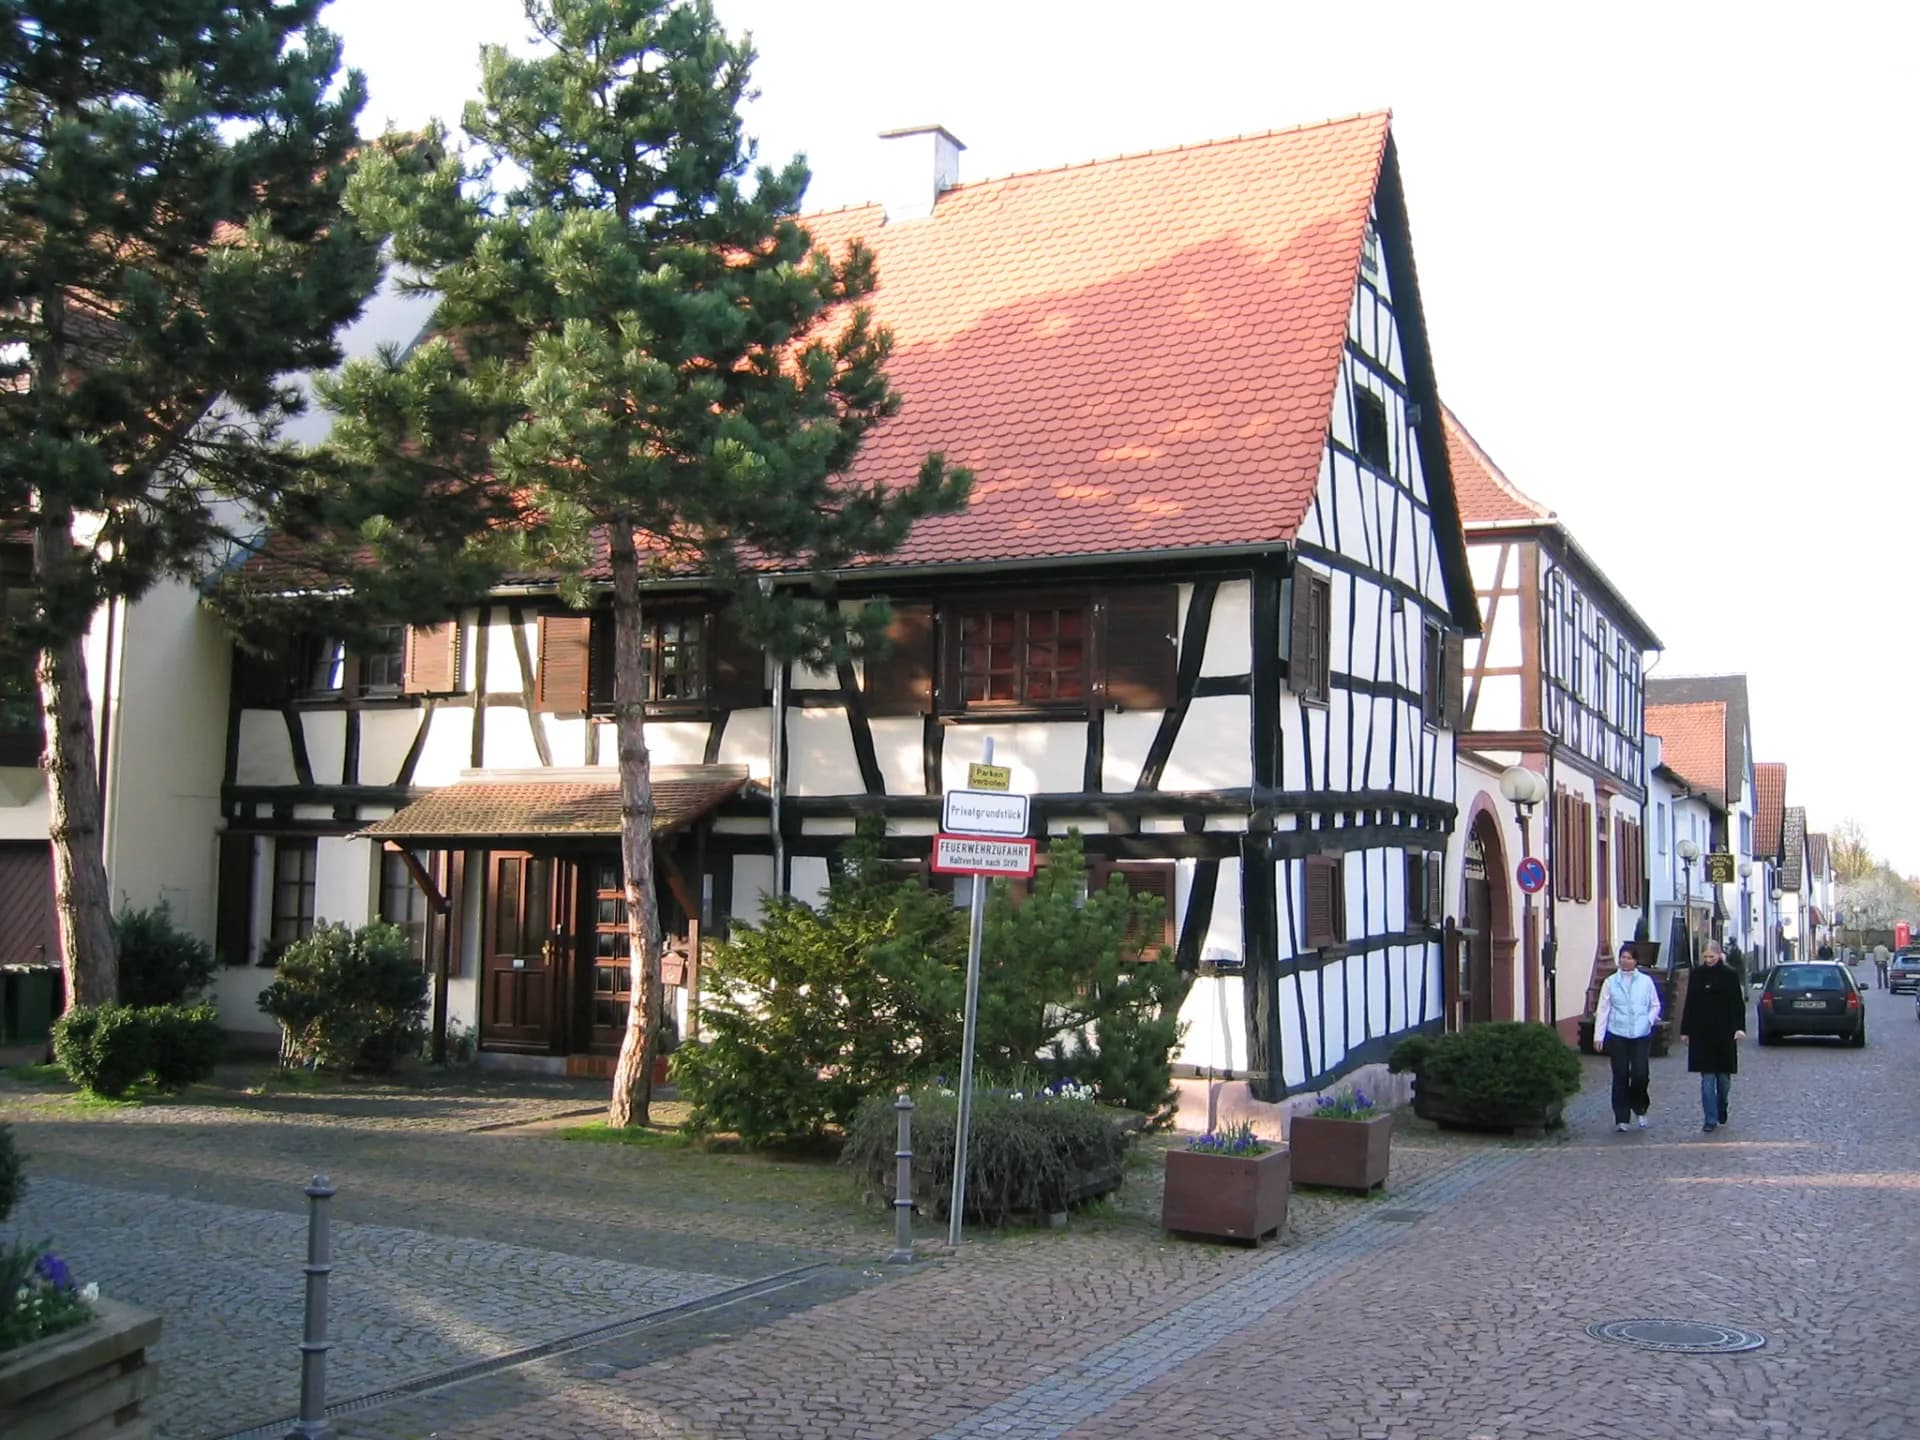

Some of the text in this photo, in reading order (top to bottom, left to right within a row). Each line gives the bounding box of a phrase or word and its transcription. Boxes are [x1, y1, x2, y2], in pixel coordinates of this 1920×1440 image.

[976, 768, 1003, 777] Parken
[972, 778, 1006, 787] verboten
[951, 805, 1021, 820] Privatgrundstück
[940, 842, 1029, 857] FEUERWEHRZUFAHRT
[985, 858, 1000, 866] nach
